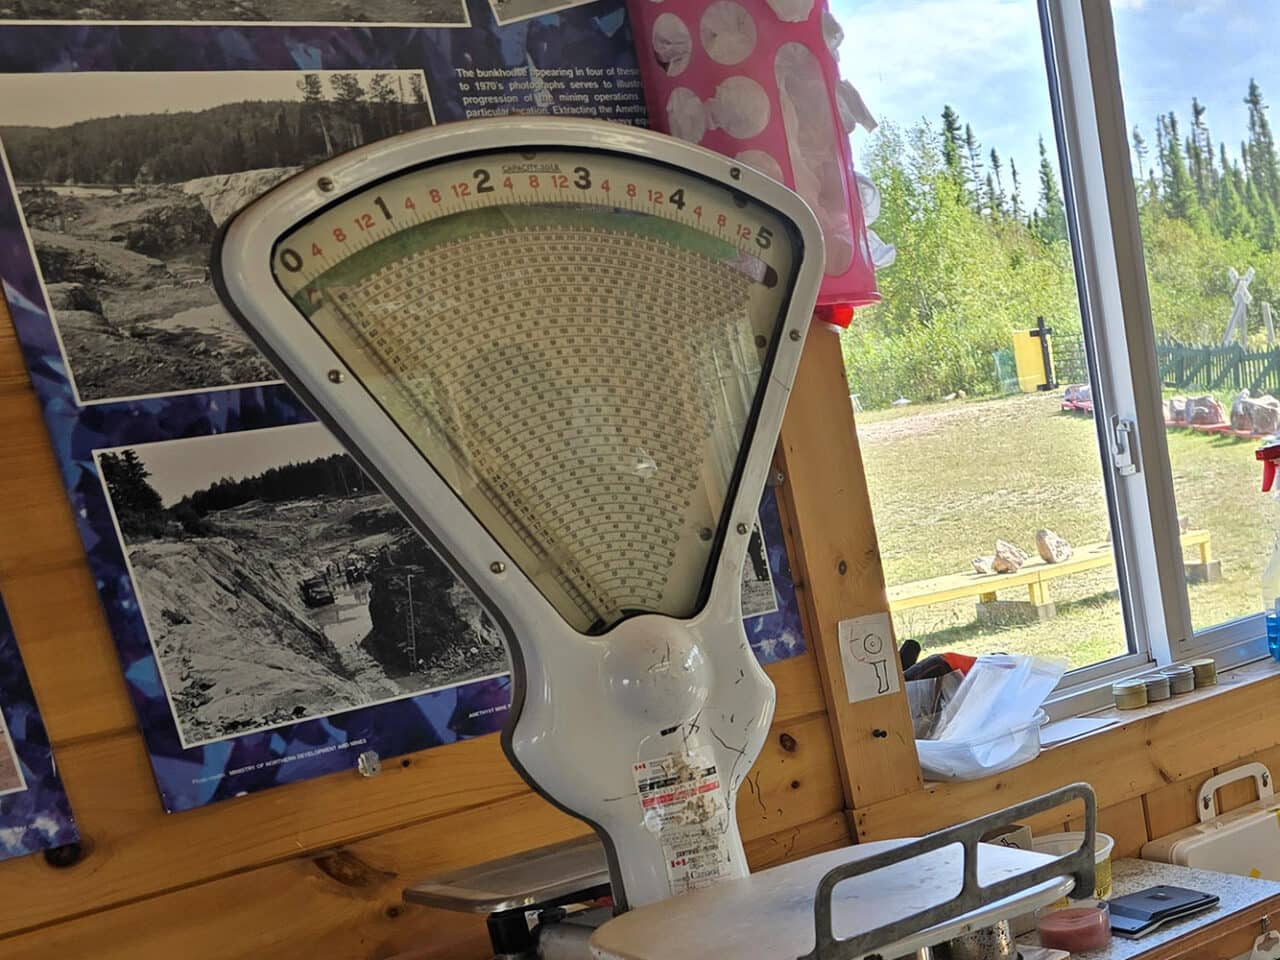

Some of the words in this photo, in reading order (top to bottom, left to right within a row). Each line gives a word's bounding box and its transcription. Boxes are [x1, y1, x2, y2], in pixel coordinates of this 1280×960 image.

[456, 68, 475, 78] The
[476, 66, 528, 78] bunkhouse
[576, 66, 584, 76] in
[586, 66, 603, 76] four
[606, 66, 615, 76] of
[459, 82, 470, 91] to
[475, 81, 504, 91] 1970's
[509, 80, 566, 92] photographs
[570, 81, 599, 89] serves
[603, 80, 612, 89] to
[463, 95, 518, 106] progression
[524, 93, 533, 102] of
[559, 93, 589, 104] mining
[594, 93, 638, 103] operations
[466, 107, 509, 119] particular
[552, 105, 598, 116] Extracting
[598, 105, 613, 113] the
[280, 249, 303, 273] 0
[311, 243, 323, 257] 4
[333, 228, 347, 243] 8
[354, 214, 376, 232] 12
[374, 196, 393, 220] 1
[405, 197, 416, 211] 4
[429, 189, 442, 204] 8
[451, 182, 472, 198] 12
[473, 169, 495, 194] 2
[503, 176, 514, 190] 4
[529, 175, 539, 188] 8
[552, 175, 570, 189] 12
[574, 166, 592, 190] 3
[601, 179, 610, 192] 4
[626, 183, 637, 198] 8
[648, 190, 664, 205] 12
[669, 188, 686, 210] 4
[693, 205, 702, 218] 4
[717, 214, 727, 226] 8
[736, 223, 752, 239] 12
[755, 226, 774, 249] 5
